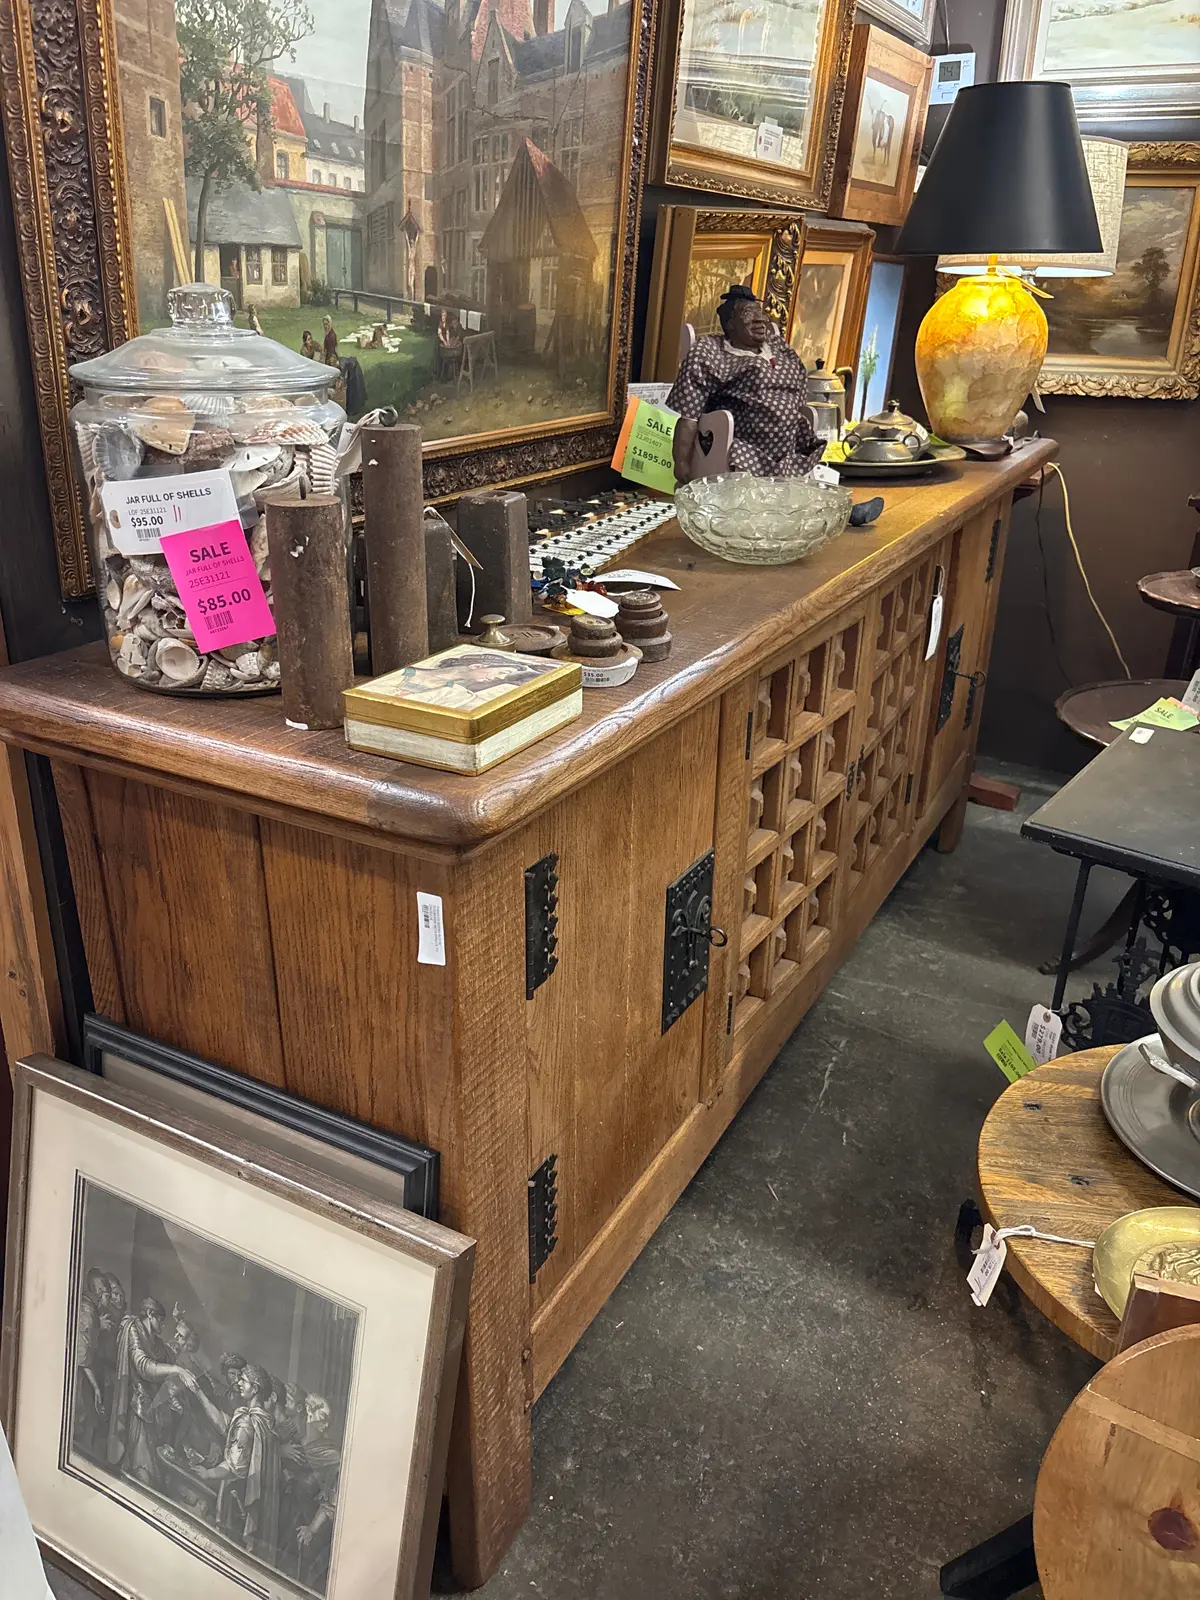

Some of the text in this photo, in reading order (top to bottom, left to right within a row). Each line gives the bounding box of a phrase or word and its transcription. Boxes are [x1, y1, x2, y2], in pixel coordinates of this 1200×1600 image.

[646, 418, 673, 436] SALE
[632, 446, 672, 469] $1895.00
[126, 487, 212, 505] JAR FULL OF SHELLS
[140, 507, 167, 515] 25E31121
[130, 515, 164, 528] $95.00
[189, 542, 232, 564] SALE
[185, 555, 245, 576] JAR FULL OF SHELLS
[188, 570, 231, 589] 25E31121
[197, 588, 252, 615] $85.00
[1154, 707, 1174, 719] SALE
[1035, 1024, 1046, 1054] $279.00
